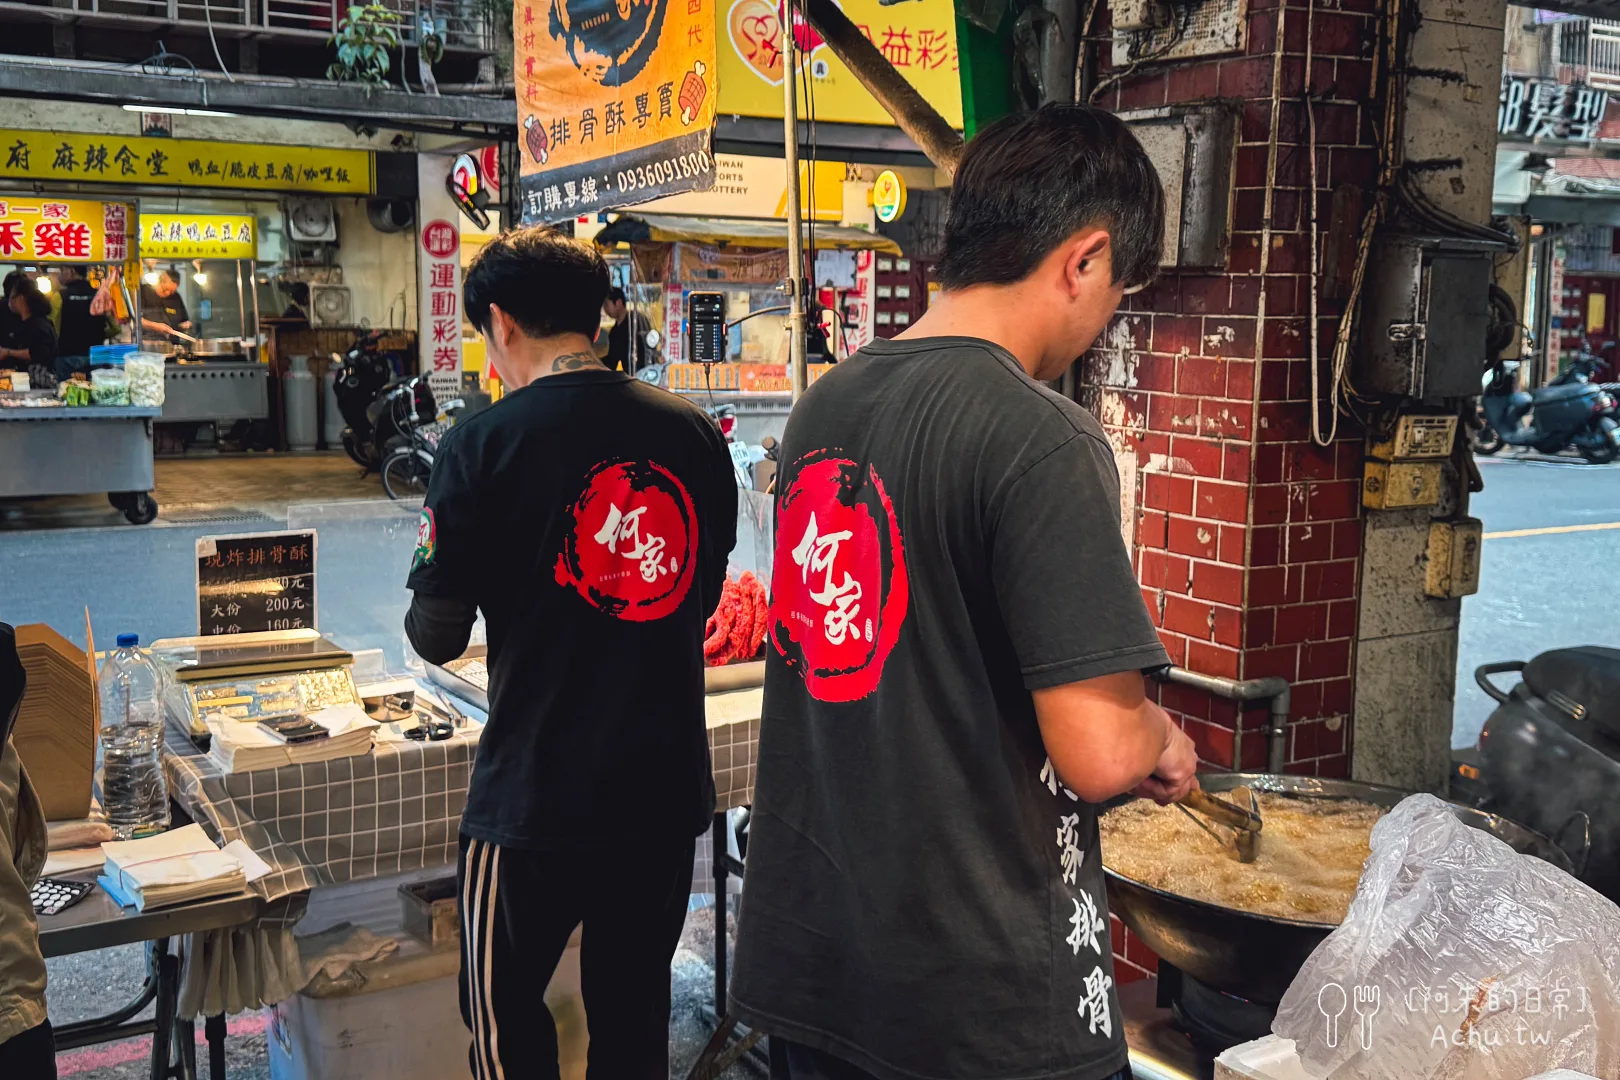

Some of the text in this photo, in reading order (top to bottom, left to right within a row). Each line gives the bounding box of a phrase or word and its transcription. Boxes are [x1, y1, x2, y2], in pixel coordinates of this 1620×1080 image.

[855, 23, 959, 72] 益彩
[549, 81, 675, 151] 排骨酥專賣
[5, 139, 32, 172] 府
[52, 142, 170, 177] 麻辣食堂
[718, 172, 744, 181] ORTS
[719, 160, 744, 168] IWAN
[712, 185, 749, 194] OTTERY
[430, 263, 458, 372] 運動彩券
[205, 543, 309, 569] 現炸排骨酥
[594, 502, 667, 583] 何家
[792, 510, 863, 646] 何家
[210, 596, 305, 618] 大份 200元
